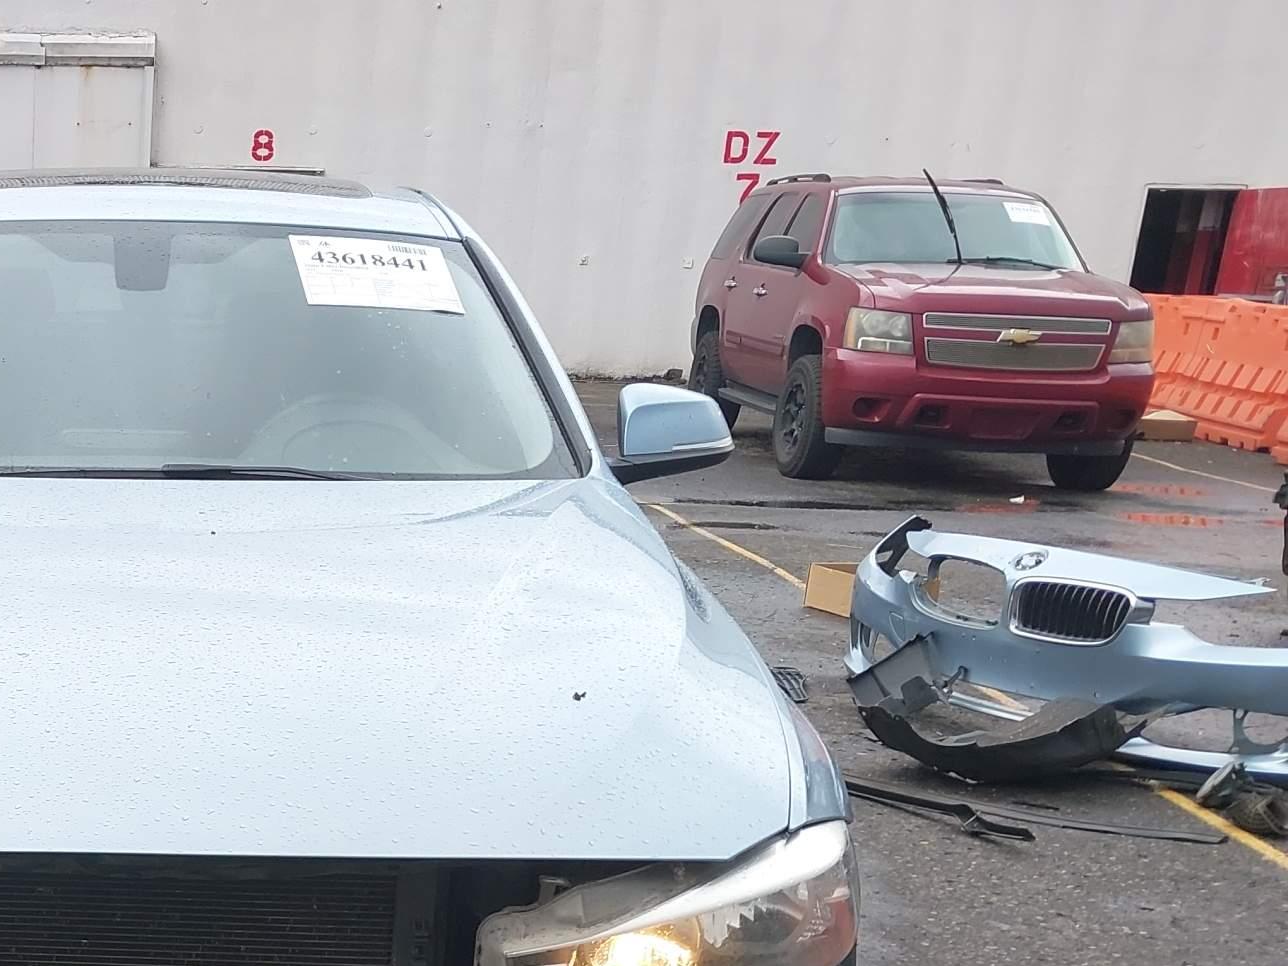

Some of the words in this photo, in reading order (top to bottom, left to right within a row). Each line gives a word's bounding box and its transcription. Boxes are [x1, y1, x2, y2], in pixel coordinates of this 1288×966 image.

[252, 129, 274, 161] 8
[723, 131, 781, 165] DZ
[311, 250, 428, 272] 43618441
